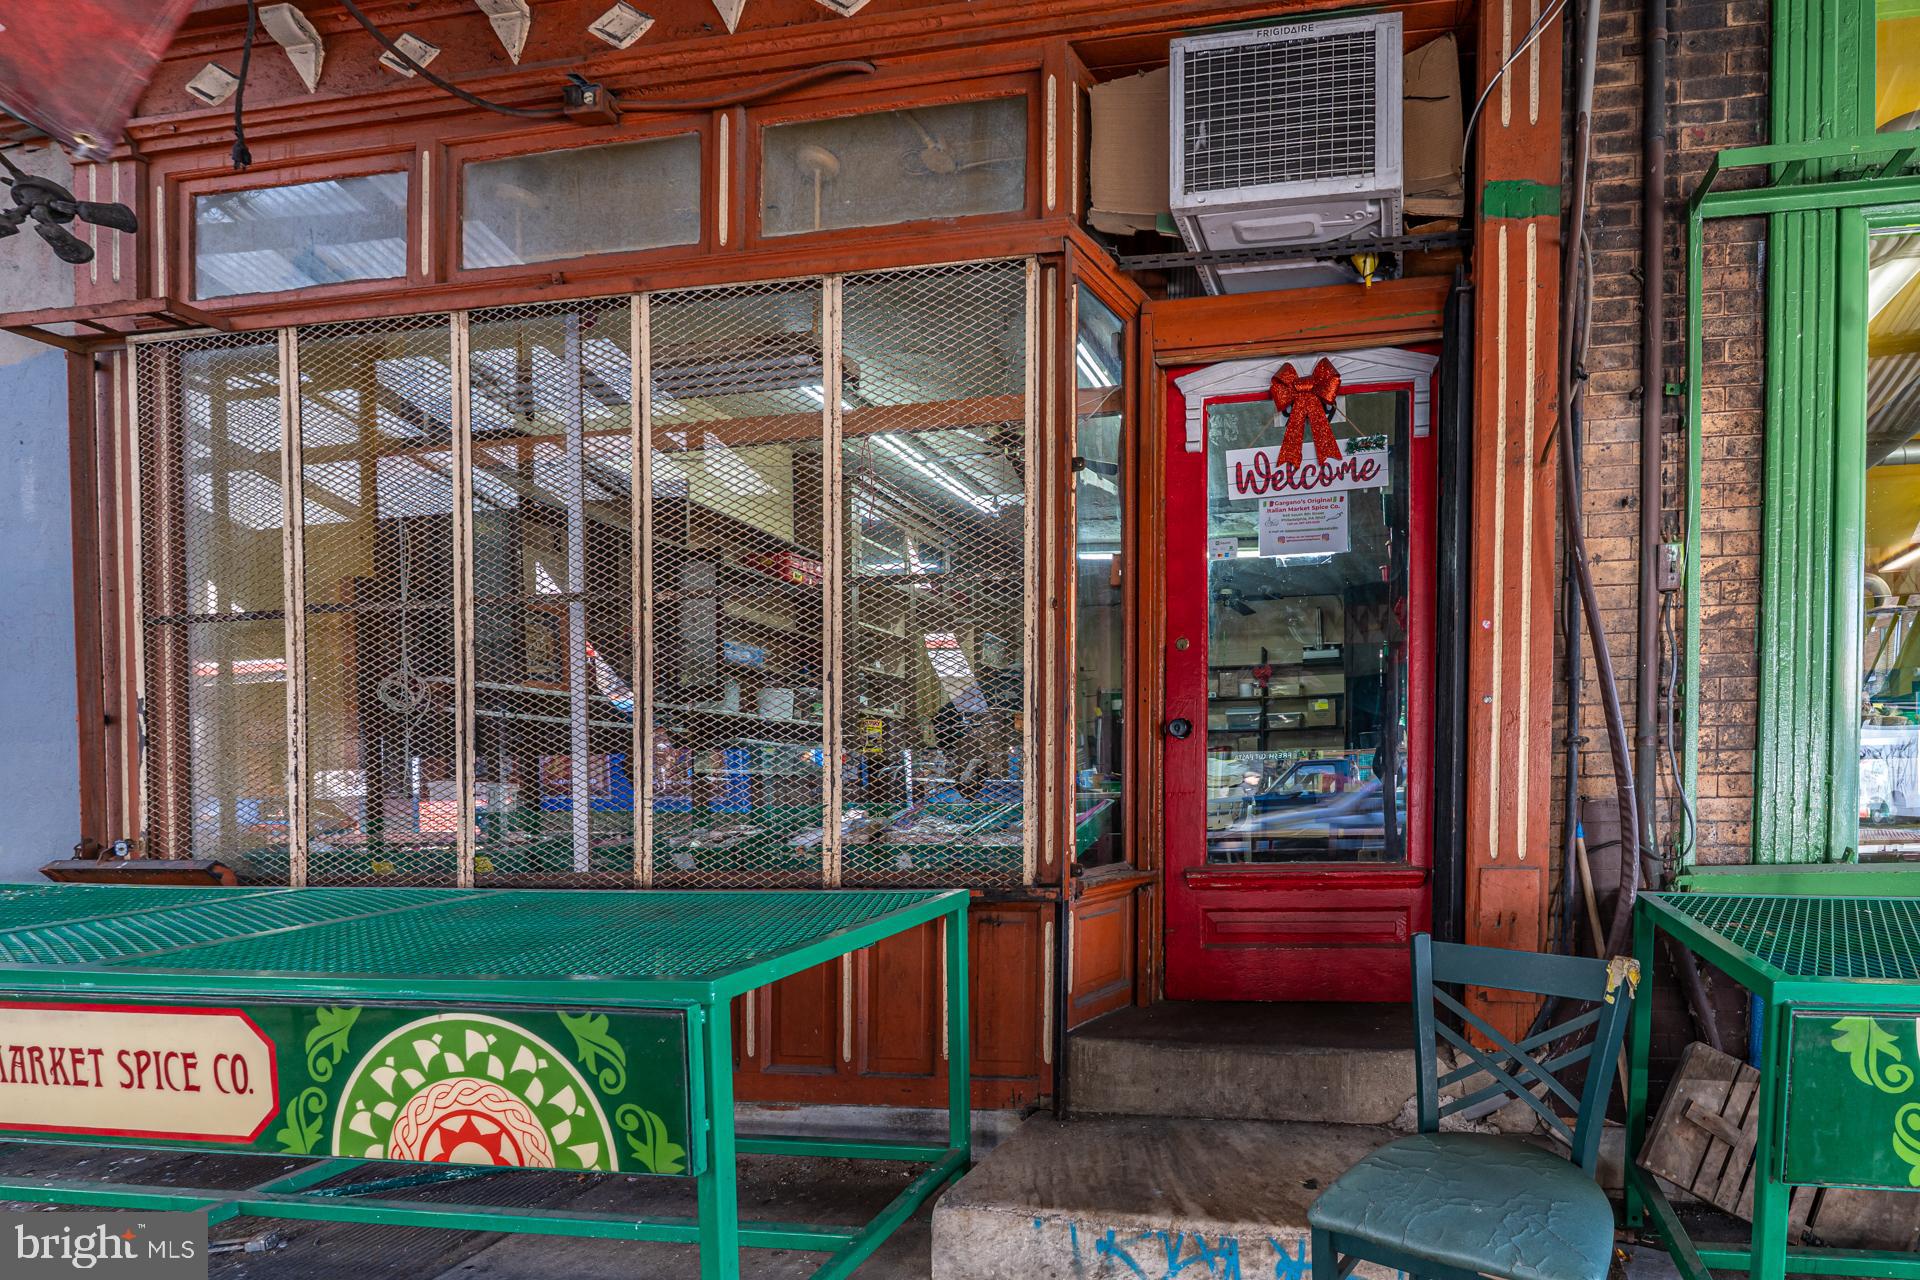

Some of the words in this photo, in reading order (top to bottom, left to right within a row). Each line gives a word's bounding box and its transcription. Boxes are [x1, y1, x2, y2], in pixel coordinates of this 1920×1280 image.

[1256, 23, 1314, 38] FRIGIDAIRE
[1235, 451, 1381, 495] Welcome
[1274, 499, 1306, 507] Gargano's
[117, 1049, 200, 1092] SPICE
[213, 1053, 254, 1095] CO.
